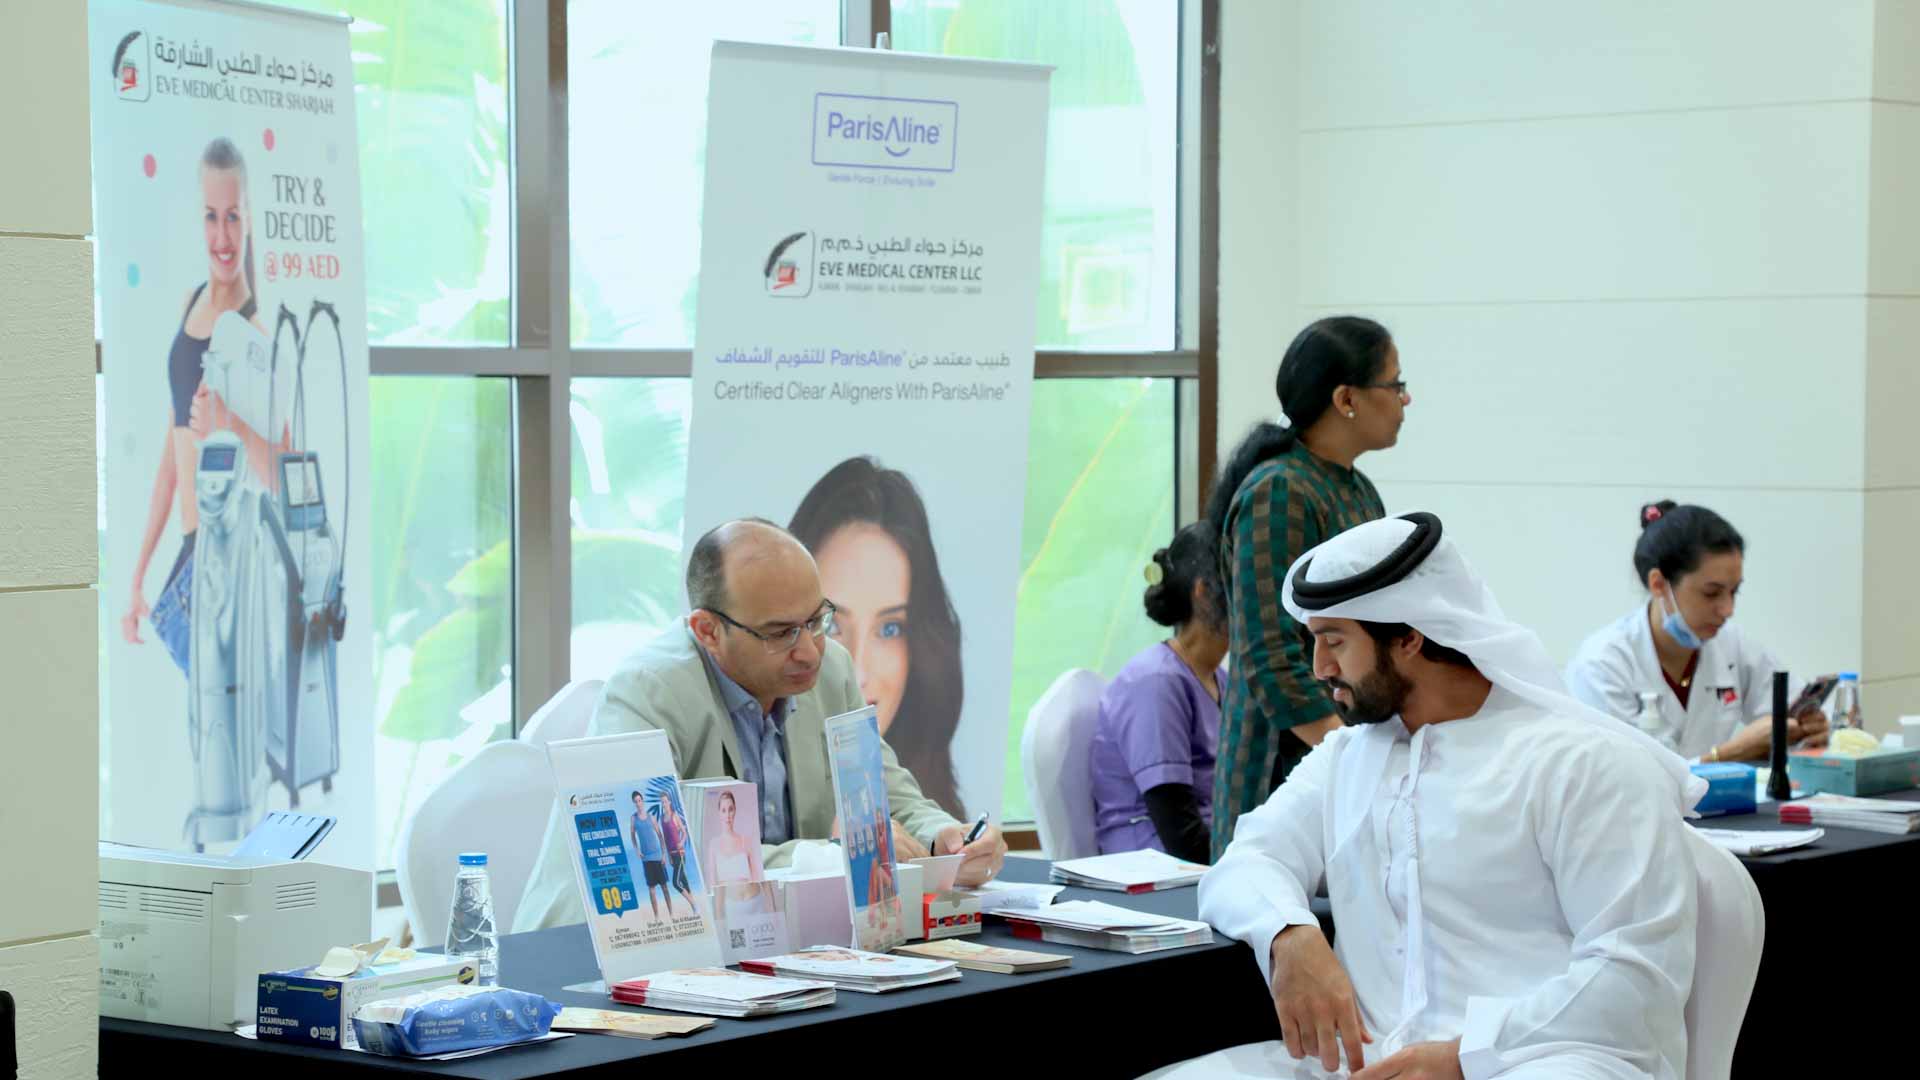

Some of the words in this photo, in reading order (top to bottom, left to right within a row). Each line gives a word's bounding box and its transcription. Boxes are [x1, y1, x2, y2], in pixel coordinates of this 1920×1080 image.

[154, 36, 213, 69] الشارقة
[216, 50, 262, 82] الطبي
[266, 56, 297, 83] حواء
[302, 59, 335, 88] مركز
[156, 75, 180, 96] EVE
[183, 79, 238, 103] MEDICAL
[240, 86, 284, 110] CENTER
[286, 93, 335, 115] SHARJAH
[272, 174, 308, 205] TRY
[313, 177, 326, 207] &
[264, 211, 337, 243] DECIDE
[868, 236, 911, 260] الطبي
[914, 237, 946, 256] حواء
[950, 236, 984, 257] مركز
[265, 252, 278, 282] @
[282, 252, 303, 279] 99
[309, 254, 340, 279] AED
[819, 262, 843, 277] EVE
[847, 263, 905, 279] MEDICAL
[909, 265, 958, 280] CENTER
[961, 266, 983, 281] LLC
[908, 352, 929, 369] من
[714, 380, 784, 401] Certified
[787, 381, 826, 401] Clear
[830, 381, 893, 405] Aligners
[896, 381, 928, 401] With
[259, 1006, 279, 1016] LATEX
[259, 1016, 299, 1028] EXAMINATION
[259, 1026, 284, 1036] GLOVES
